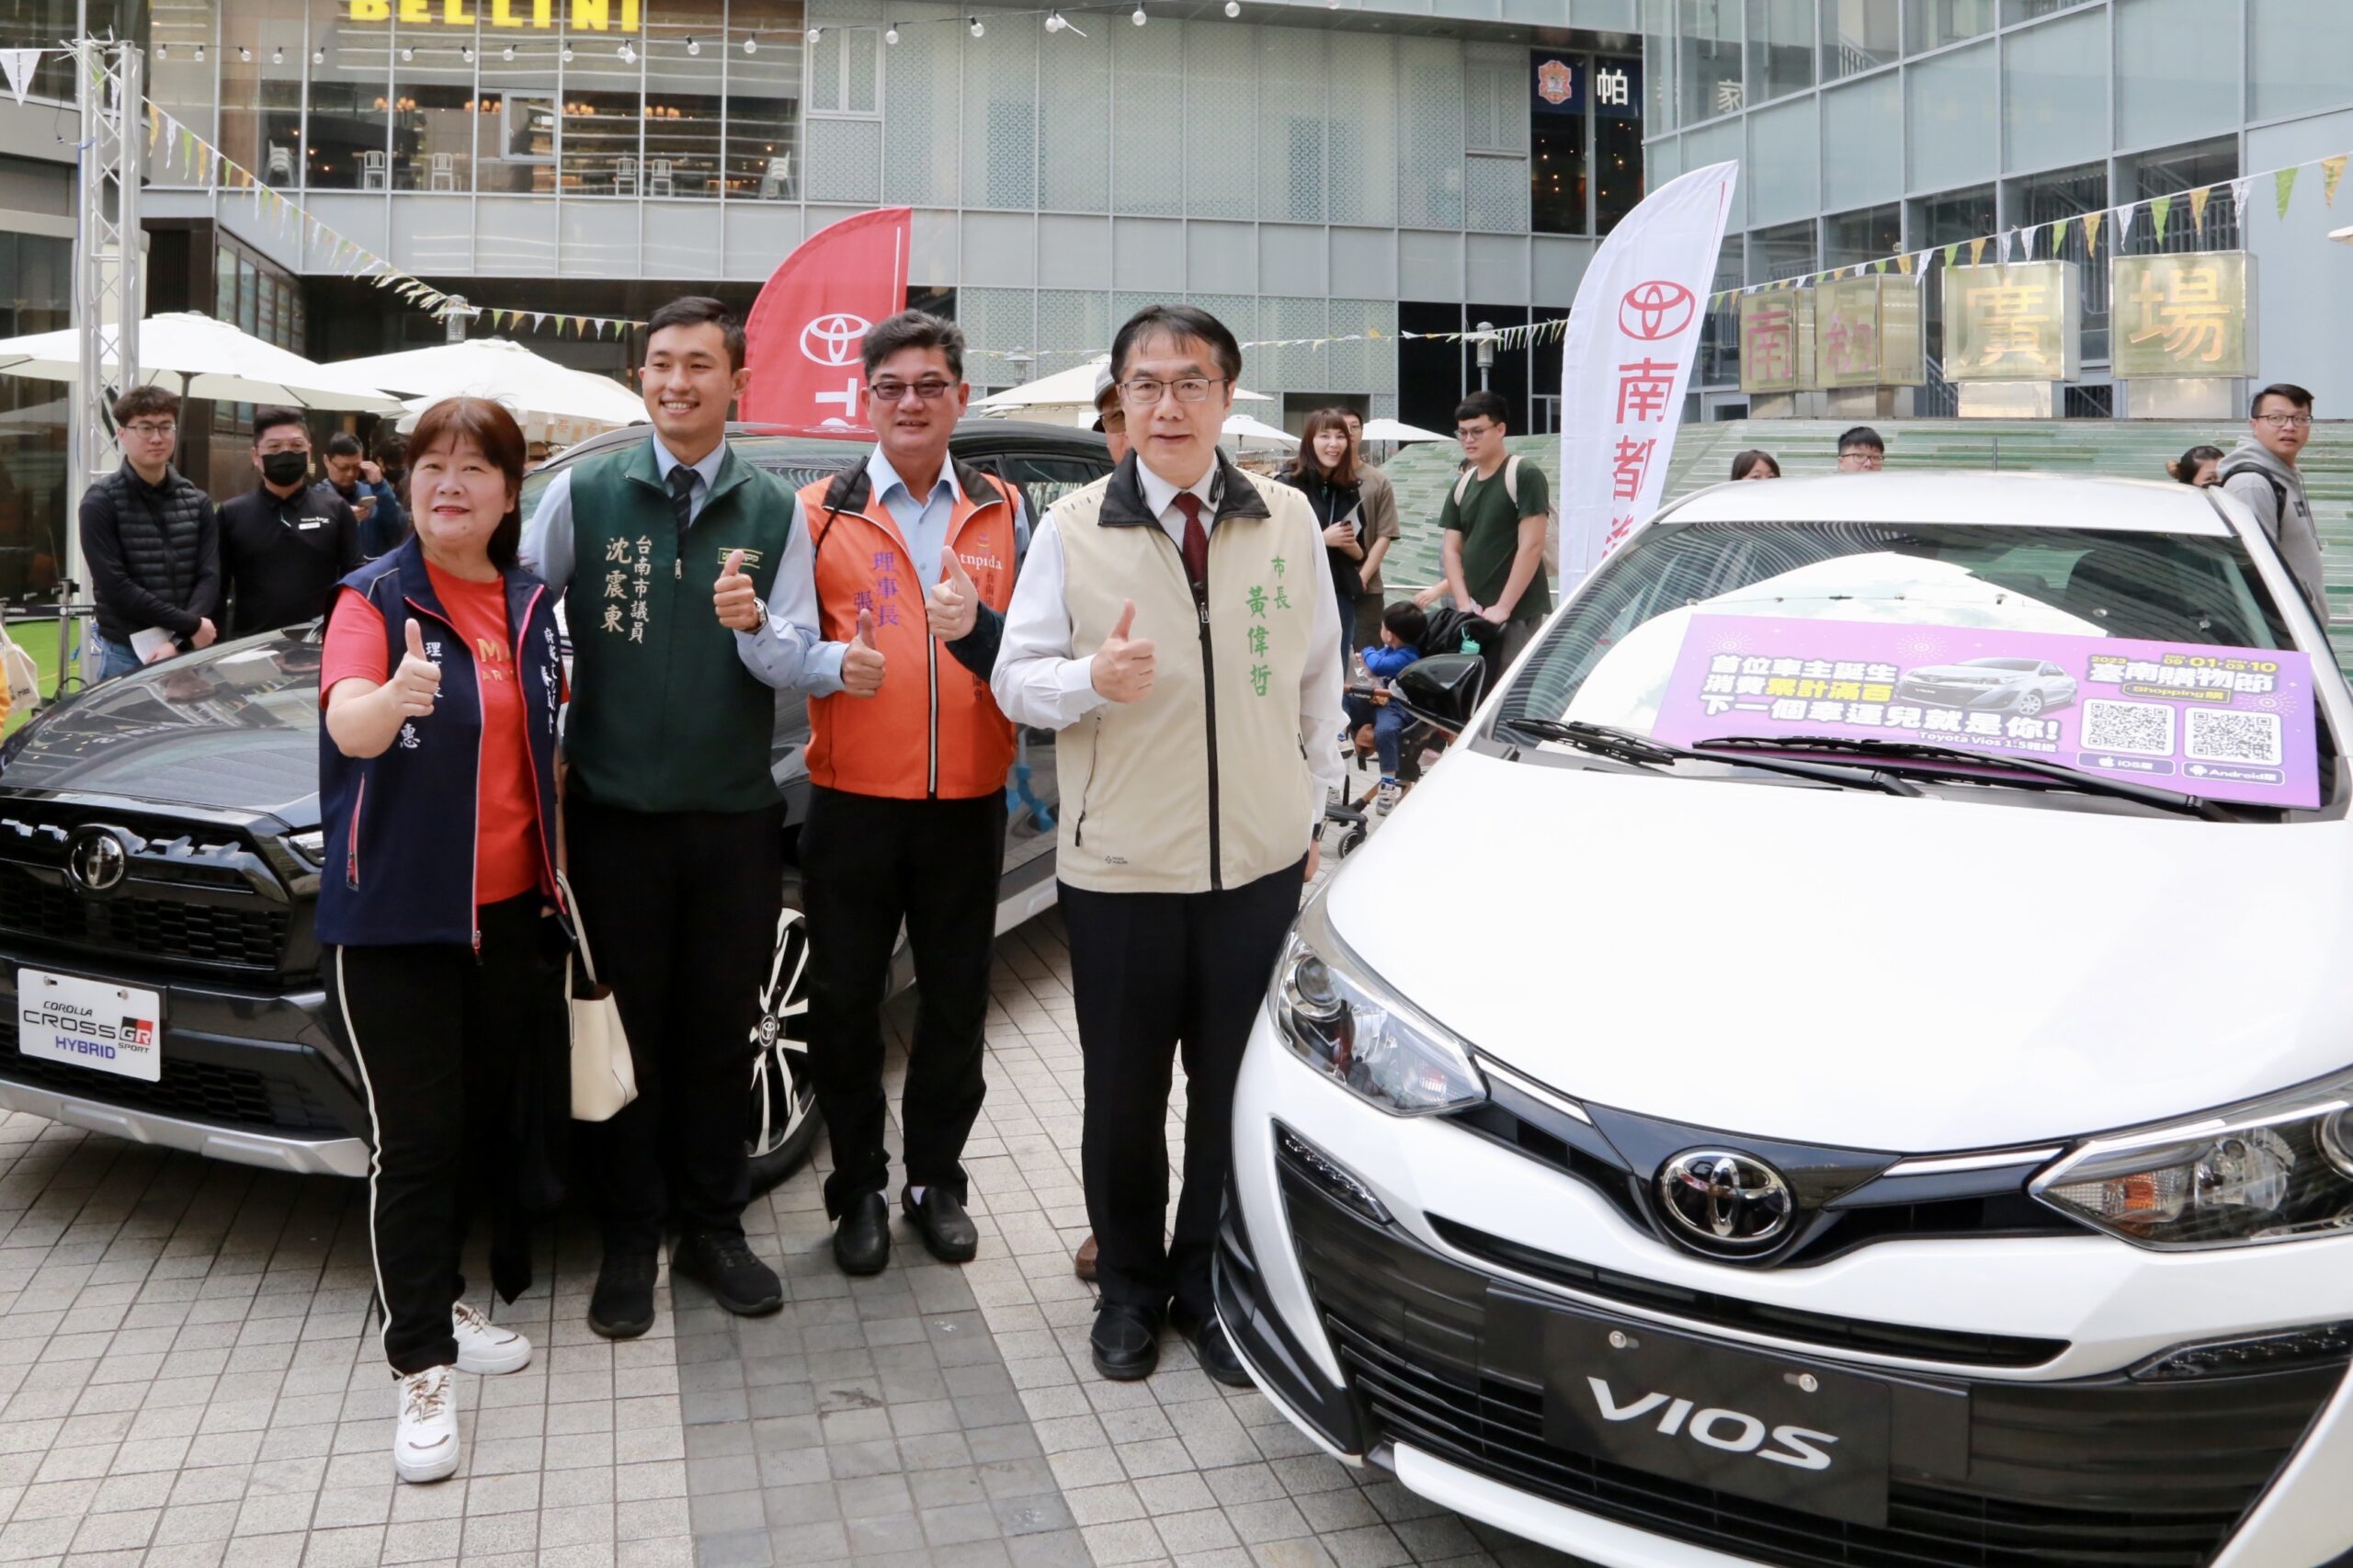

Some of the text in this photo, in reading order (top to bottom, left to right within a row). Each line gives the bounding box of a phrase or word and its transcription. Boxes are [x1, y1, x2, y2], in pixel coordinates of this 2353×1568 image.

[349, 0, 639, 31] BELLINI
[1597, 68, 1629, 106] 帕
[815, 378, 858, 426] T
[961, 553, 1003, 570] tnpida
[600, 537, 632, 632] 沈震東
[628, 535, 653, 643] 台南市議員
[872, 552, 899, 627] 理事長
[1270, 555, 1291, 609] 市長
[1245, 585, 1272, 697] 黃偉哲
[1711, 654, 1899, 683] 首位車主誕生
[1919, 732, 1969, 744] Toyota
[1971, 735, 2001, 747] Vios
[43, 1000, 93, 1017] COROLLA
[23, 1009, 116, 1040] CROSS
[119, 1026, 153, 1046] GR
[55, 1036, 116, 1060] HYBRID
[118, 1042, 150, 1054] SPORT
[1586, 1376, 1839, 1471] VIOS
